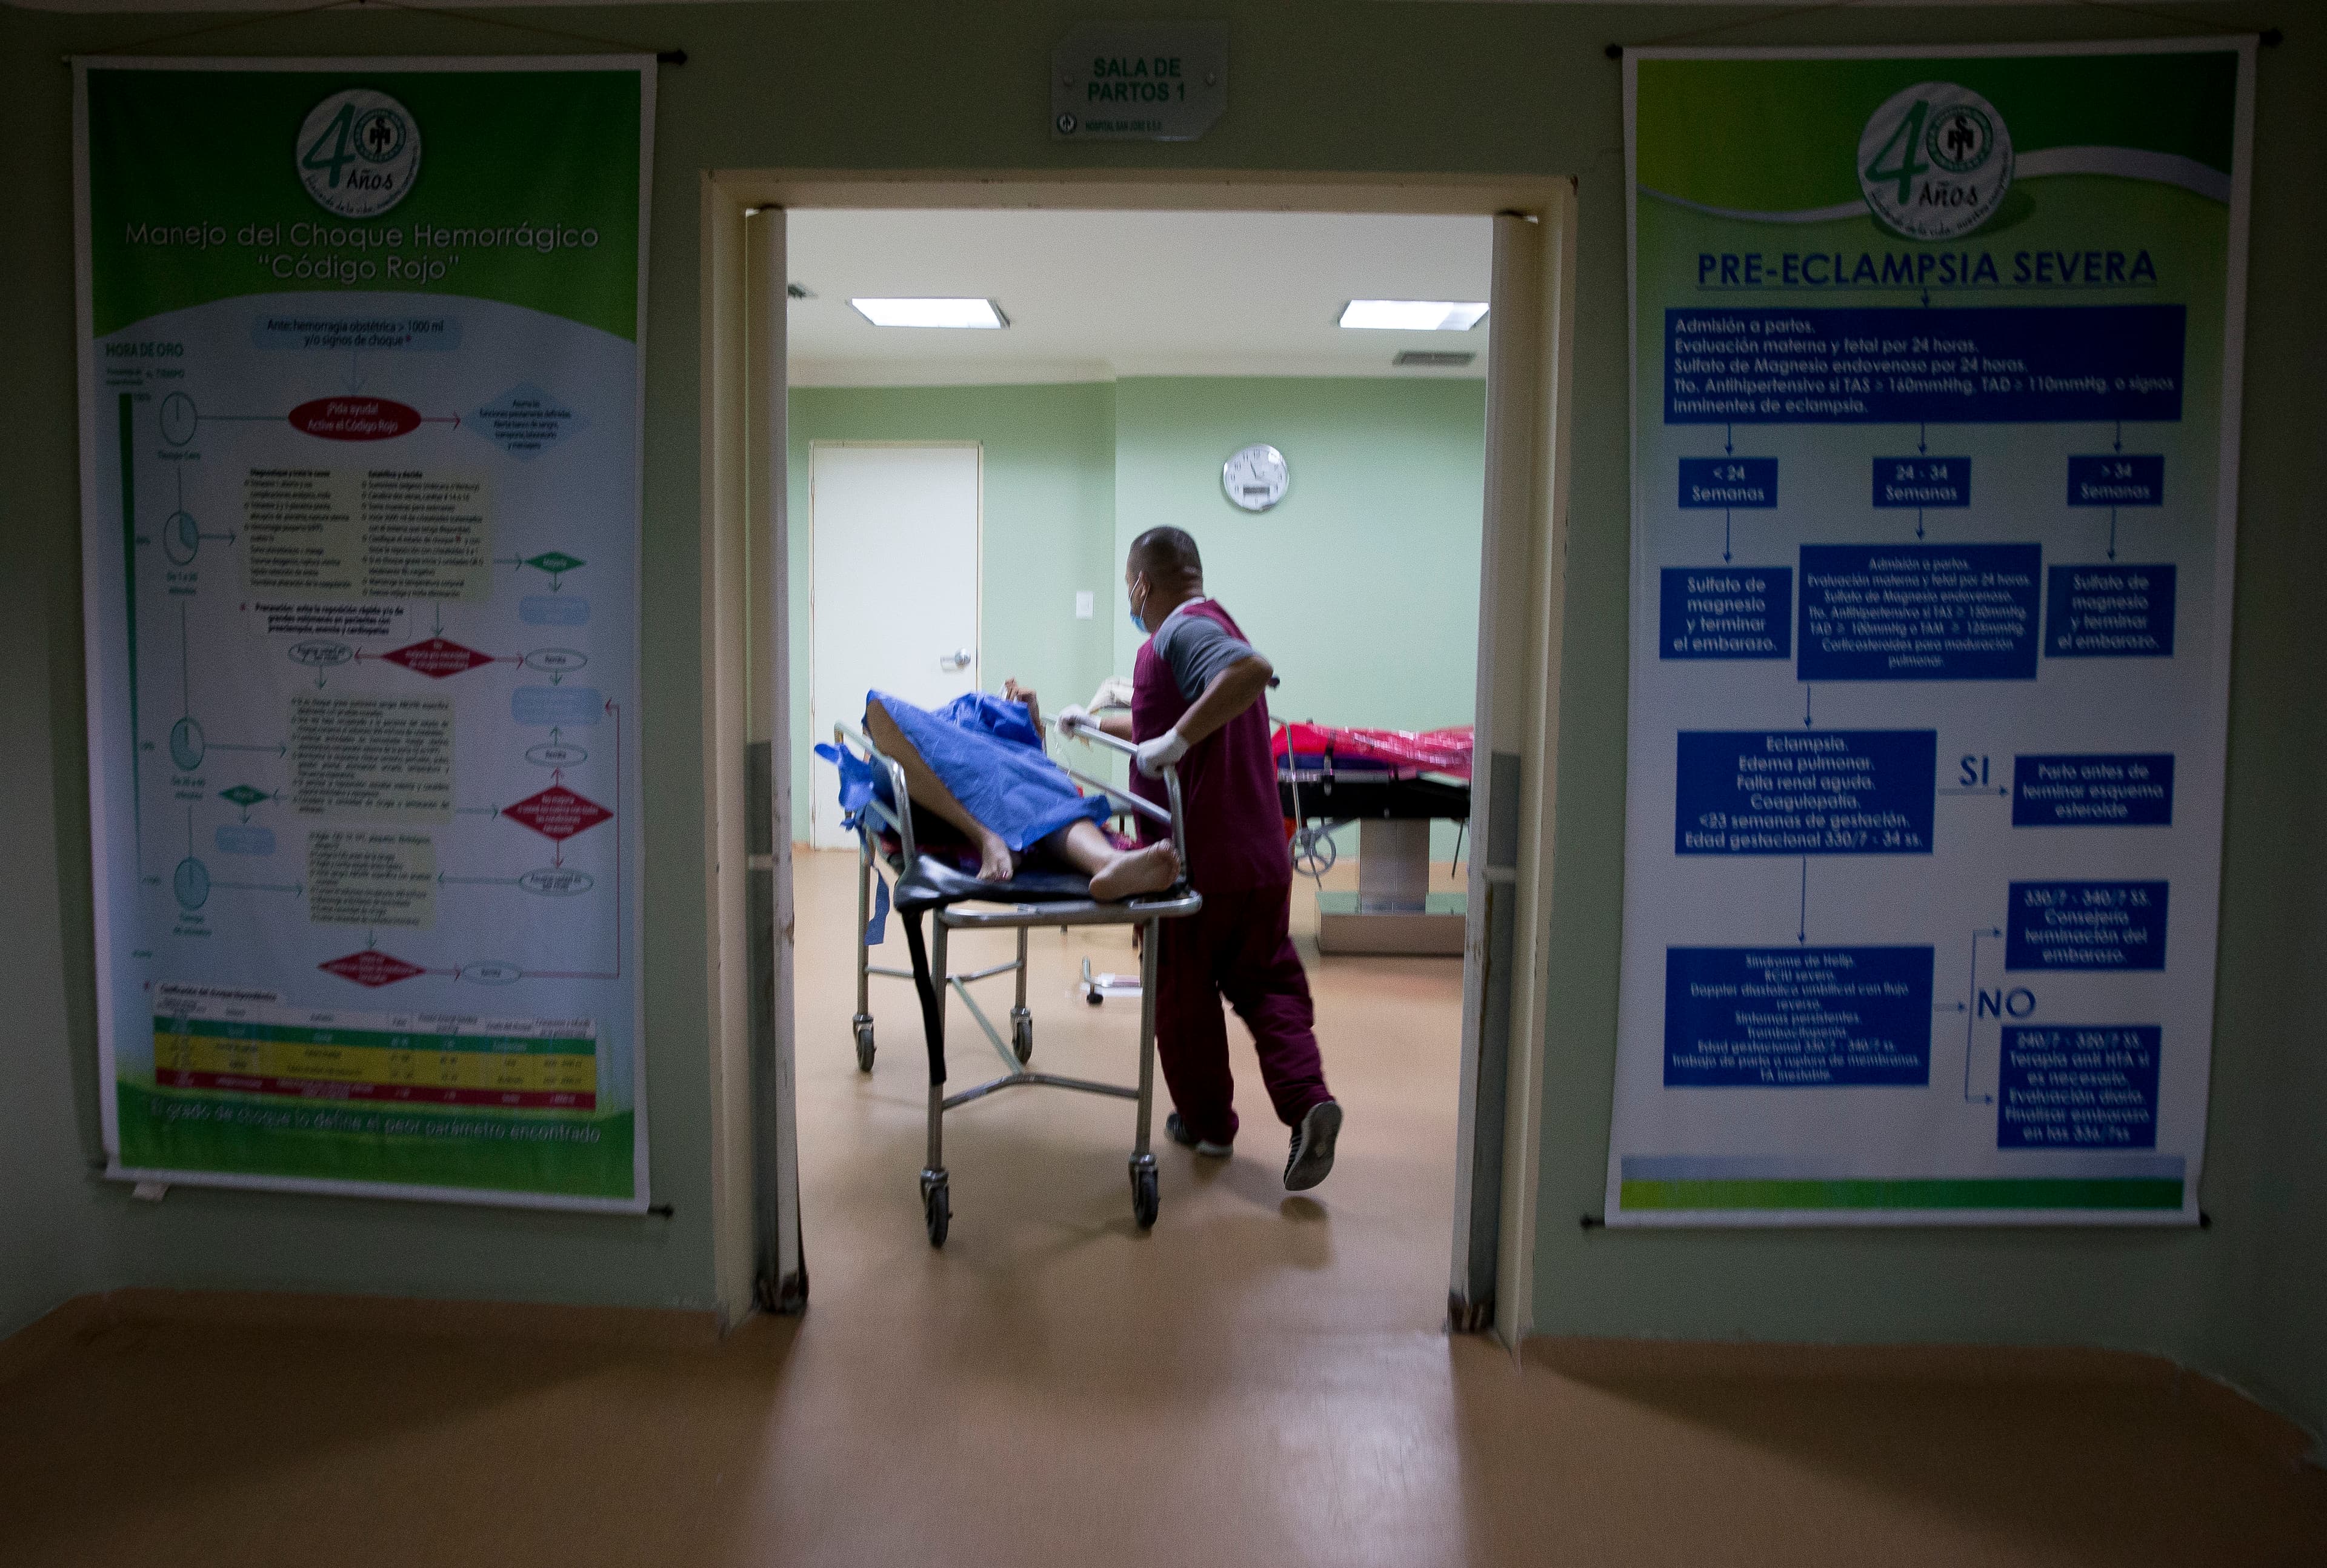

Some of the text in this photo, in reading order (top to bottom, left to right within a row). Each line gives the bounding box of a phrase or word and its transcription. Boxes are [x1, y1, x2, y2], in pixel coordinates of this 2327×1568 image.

[1094, 58, 1180, 78] SALA DE
[1088, 82, 1184, 101] PARTOS 1
[347, 169, 393, 190] Años
[1919, 182, 1978, 207] Años
[125, 220, 599, 253] Manejo del Choque Hemorrágico
[1698, 250, 2157, 284] PRE-ECLAMPSIA SEVERA
[407, 320, 430, 331] 1000
[431, 320, 444, 331] ml
[1675, 317, 1816, 335] Admisión a partos.
[105, 342, 184, 357] HORA DE ORO
[322, 335, 352, 348] signos
[354, 334, 366, 346] de
[368, 335, 404, 348] choque
[1674, 337, 1979, 356] Evaluación materna y fetal por 24 horas.
[1674, 356, 2029, 376] Sulfato de Magnesio endovenoso por 24 horas.
[1705, 378, 1826, 396] Antihipertensivo
[1829, 378, 1840, 393] si
[1844, 377, 1871, 393] TAS
[1981, 376, 2011, 392] TAD
[2114, 378, 2126, 391] o
[2129, 374, 2176, 394] signos
[1673, 397, 1869, 416] Inminentes de eclampsia.
[1726, 463, 1746, 482] 24
[1895, 464, 1949, 483] 24 34
[2113, 462, 2134, 480] 34
[1691, 485, 1765, 503] Semanas
[1885, 484, 1959, 502] Semanas
[2080, 483, 2151, 501] Semanas
[1869, 556, 1920, 571] Admisión
[1922, 559, 1930, 571] a
[1687, 576, 1767, 594] Sulfato de
[1807, 573, 1870, 588] Evaluación
[1872, 574, 1920, 587] materna
[1922, 577, 1929, 589] y
[1931, 572, 1957, 586] fetal
[1959, 575, 1977, 589] por
[2072, 574, 2150, 592] Sulfato de
[1687, 596, 1766, 615] magnesio
[1823, 590, 1863, 603] Sulfato
[1865, 590, 1880, 603] de
[1883, 589, 1938, 606] Magnesio
[2071, 594, 2149, 613] magnesio
[1934, 605, 1952, 619] TAS
[1686, 615, 1766, 635] y terminar
[1809, 621, 1832, 636] TAD
[2070, 613, 2149, 633] y terminar
[1673, 636, 1778, 652] el embarazo.
[1914, 640, 1942, 653] para
[2057, 633, 2161, 651] el embarazo.
[1766, 735, 1849, 755] Eclampsia.
[1739, 754, 1876, 774] Edema pulmonar.
[1959, 755, 1989, 787] SI
[2038, 763, 2149, 781] Parto antes de
[1736, 774, 1876, 793] Falla renal aguda.
[2023, 782, 2164, 802] terminar esquema
[1731, 814, 1802, 829] semanas
[1805, 811, 1826, 829] de
[1685, 831, 1725, 848] Edad
[1729, 830, 1820, 852] gestacional
[2122, 926, 2148, 945] del
[1977, 987, 2036, 1018] NO
[2070, 1106, 2150, 1124] embarazo
[510, 1120, 601, 1143] encontrado
